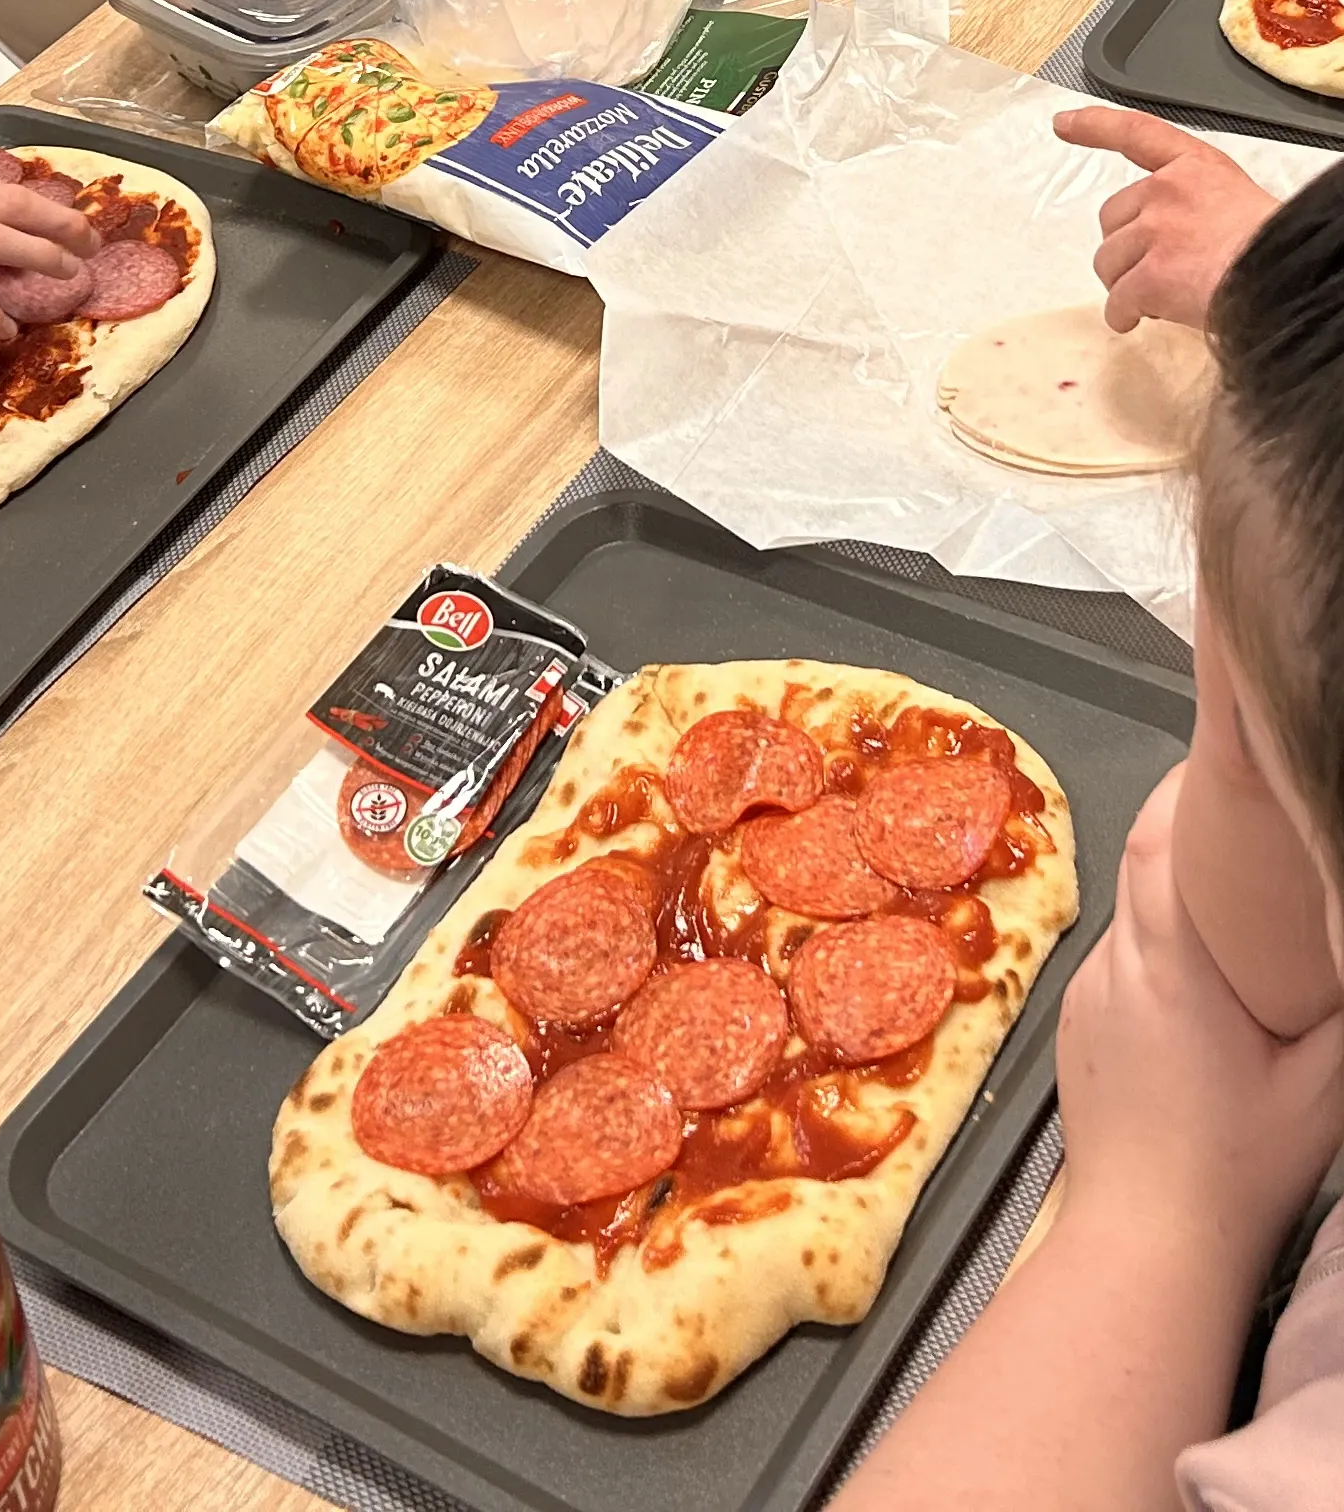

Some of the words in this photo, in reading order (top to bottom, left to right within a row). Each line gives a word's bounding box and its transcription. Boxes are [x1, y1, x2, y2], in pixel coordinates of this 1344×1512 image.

[516, 102, 640, 180] Mozzarella
[557, 125, 694, 206] Delikate
[432, 597, 483, 639] Bell
[410, 681, 493, 726] PEPPERONI
